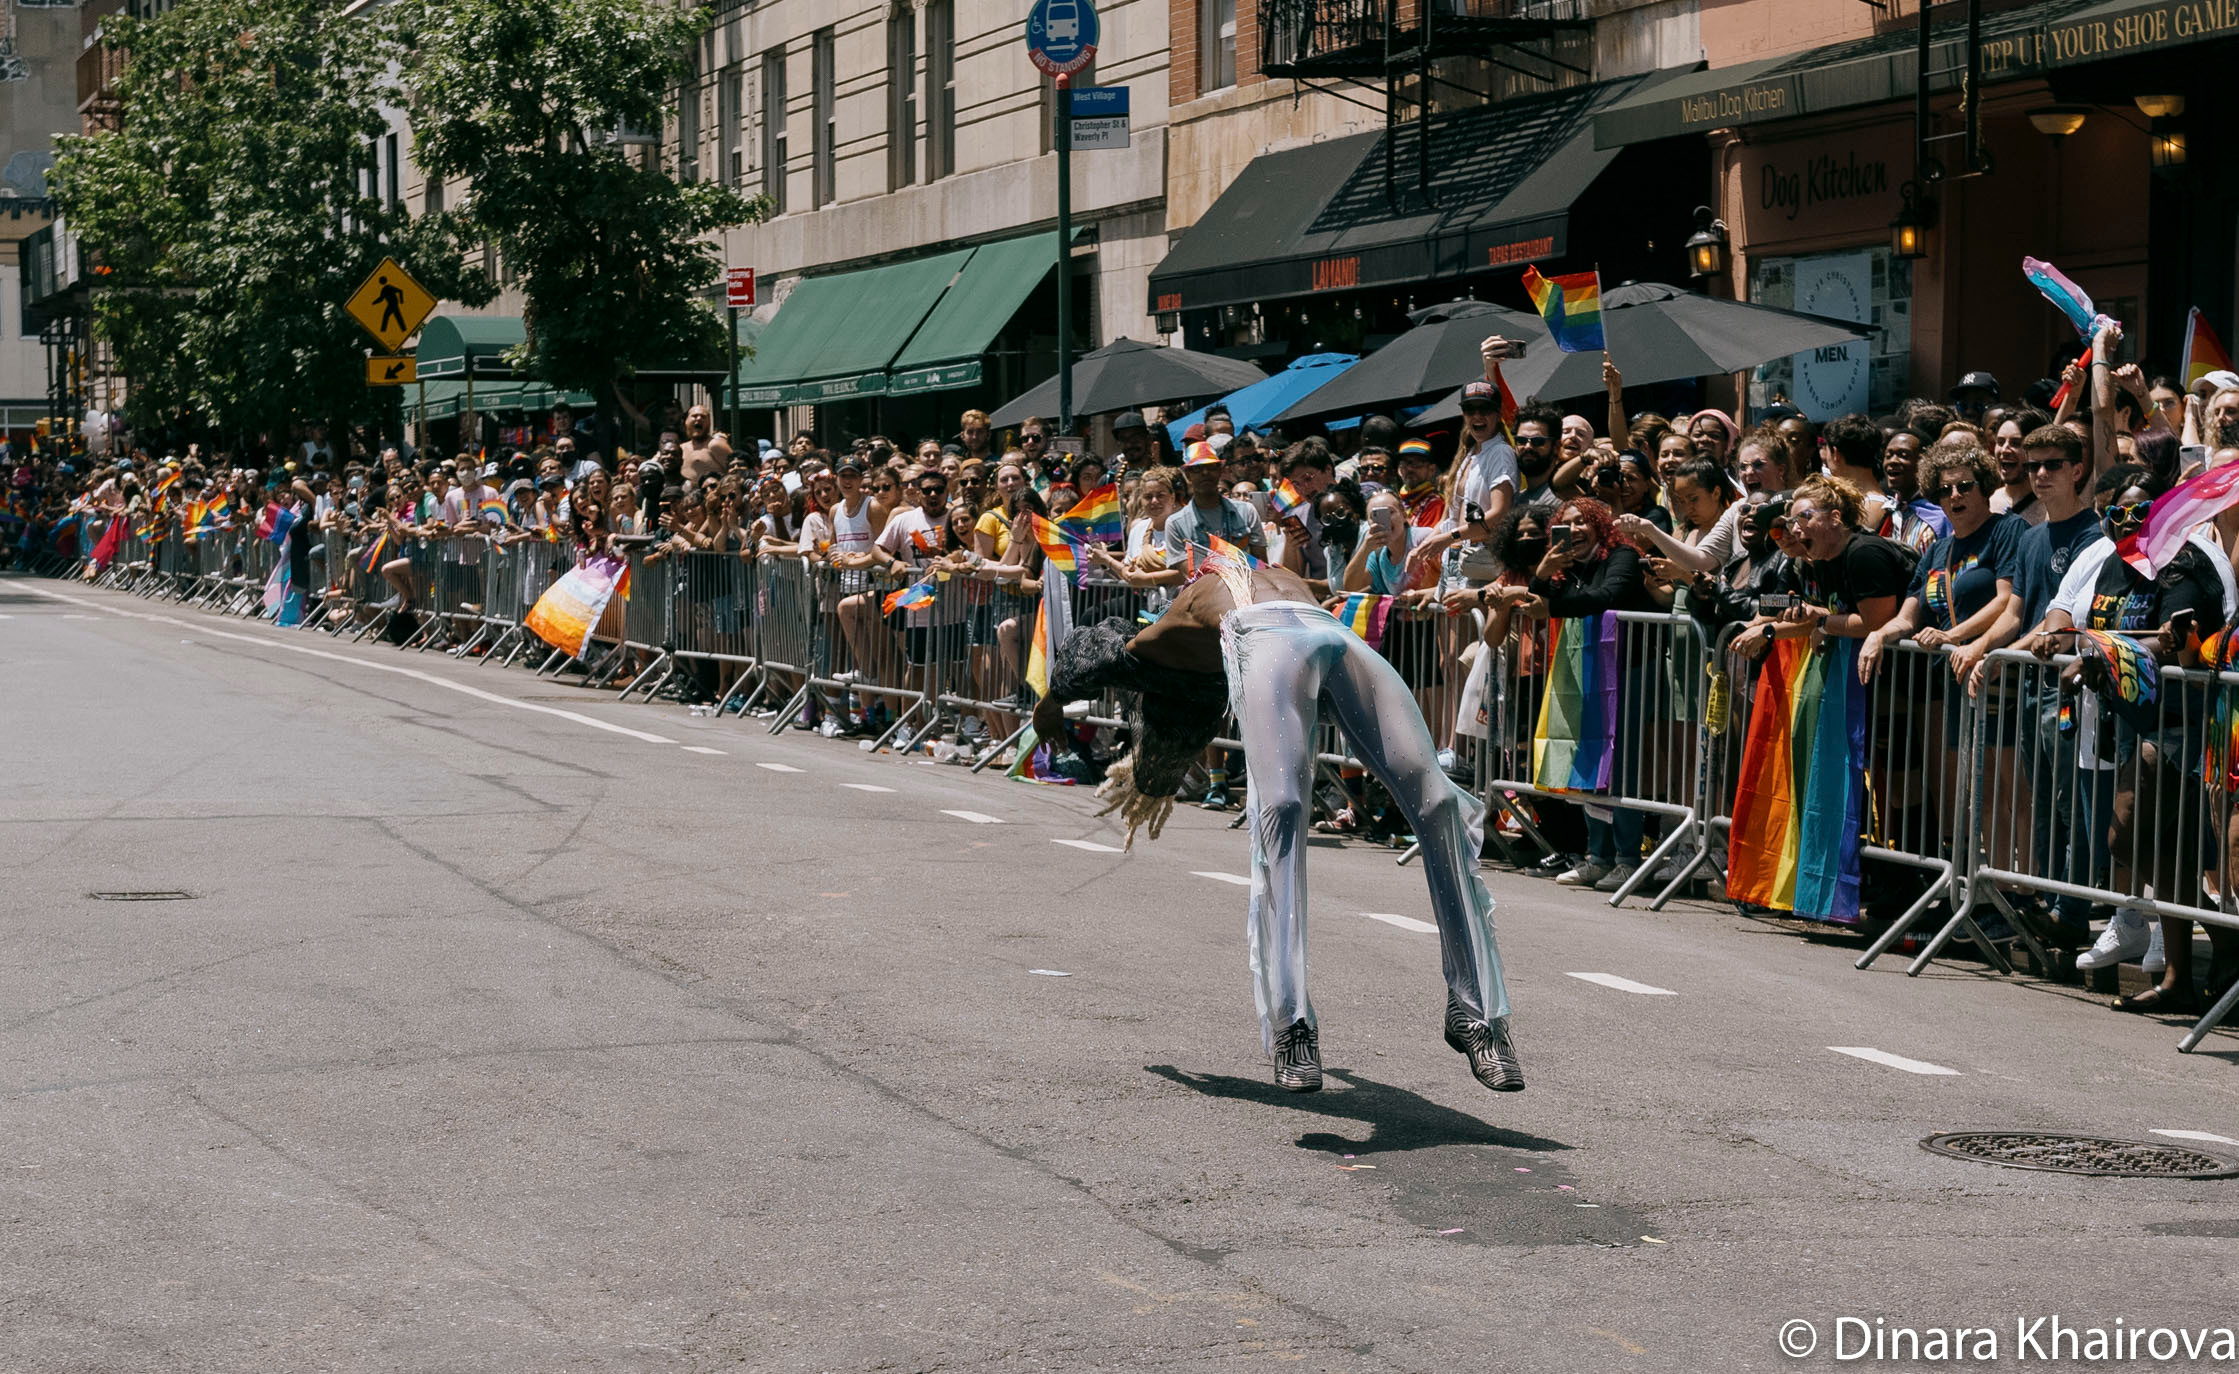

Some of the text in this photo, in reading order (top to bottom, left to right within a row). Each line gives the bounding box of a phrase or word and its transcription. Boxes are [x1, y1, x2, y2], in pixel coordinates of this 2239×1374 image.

[1979, 39, 2013, 74] TEP
[2052, 21, 2108, 61] YOUR
[2113, 8, 2168, 50] SHOE
[2174, 0, 2238, 38] GAME
[1033, 50, 1091, 73] NO STANDING
[1092, 91, 1116, 101] Village
[1681, 86, 1785, 124] Malibu Dog Kitchen
[1074, 121, 1111, 131] Christopher
[1761, 152, 1888, 221] Dog Kitchen
